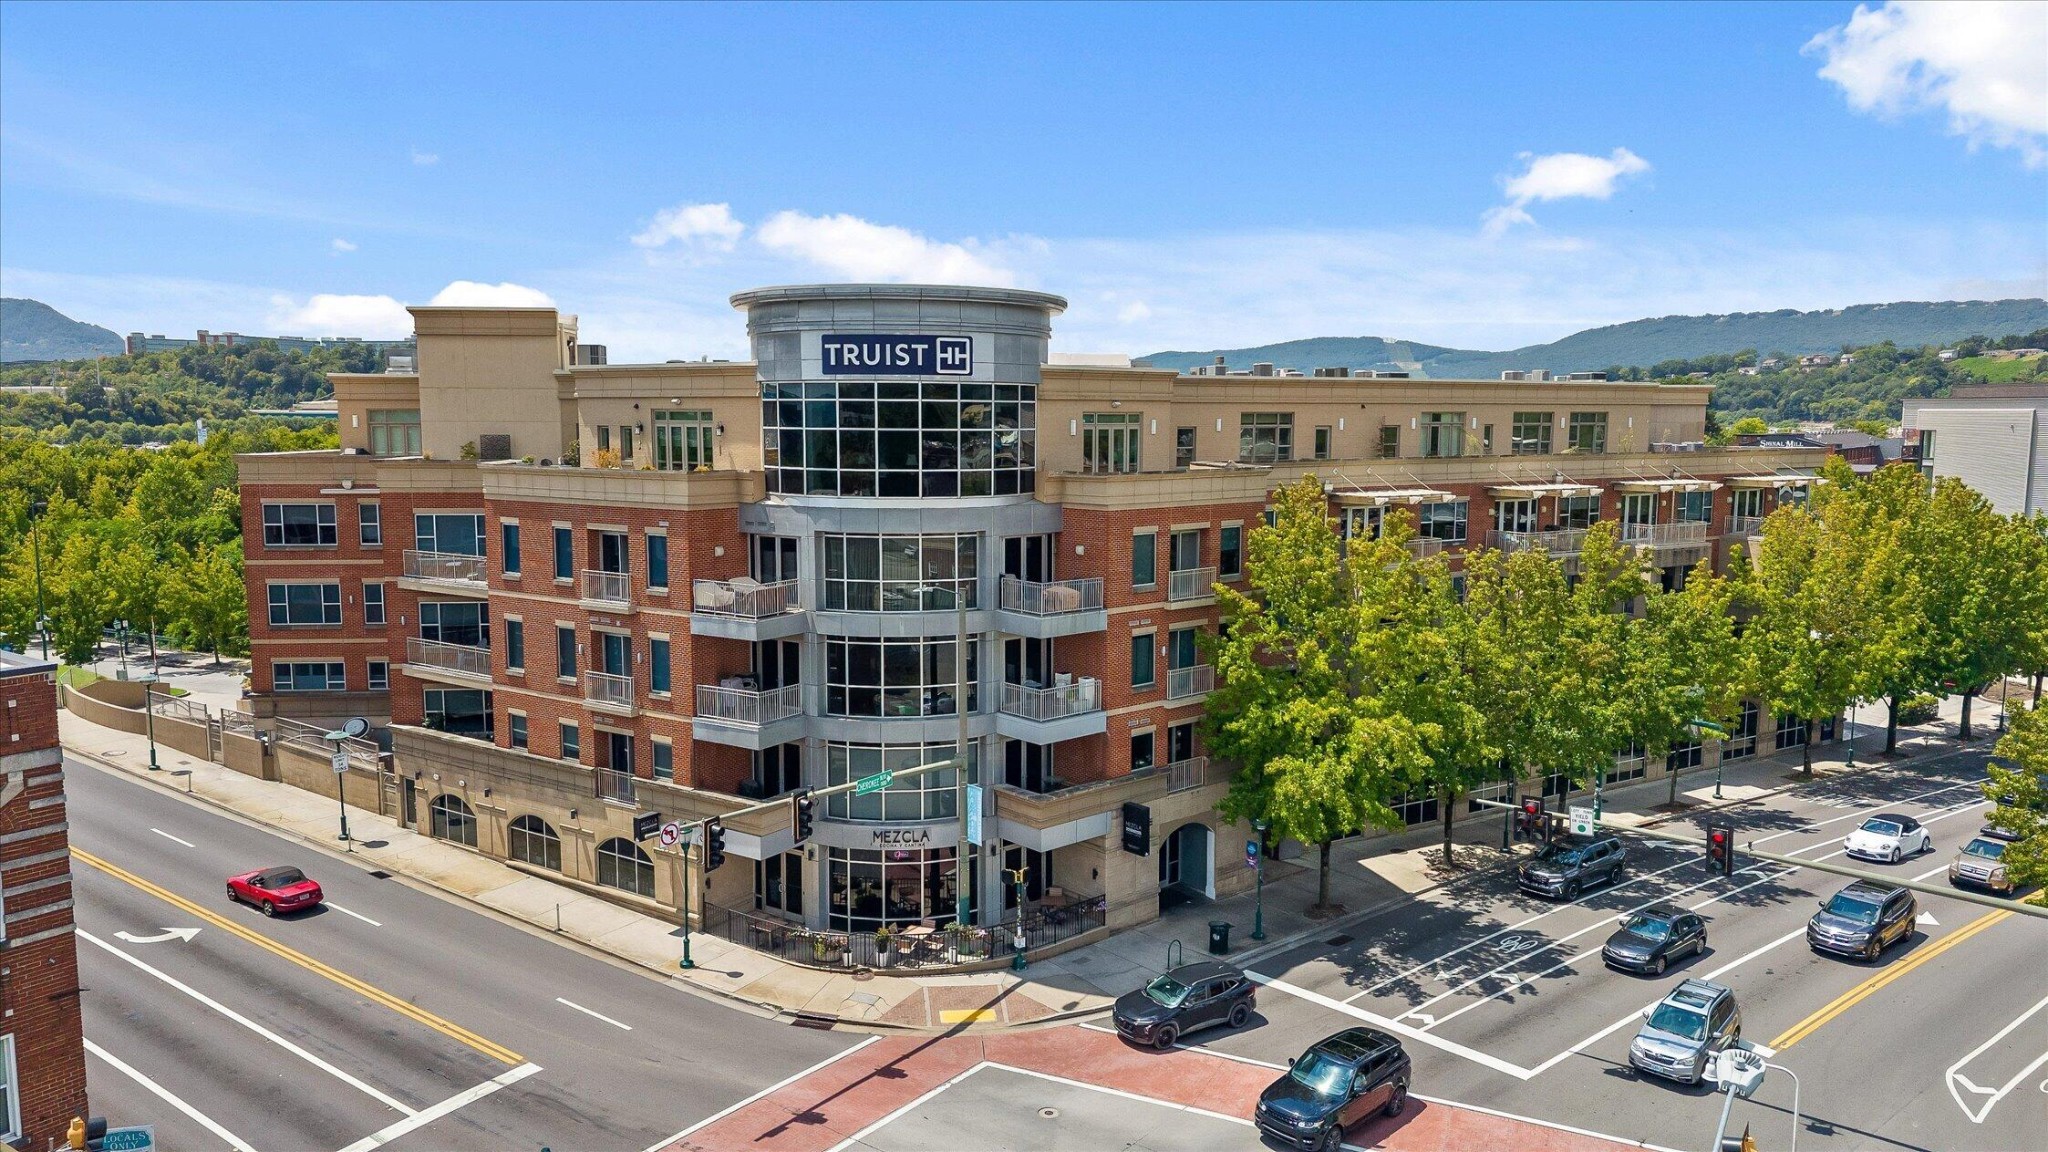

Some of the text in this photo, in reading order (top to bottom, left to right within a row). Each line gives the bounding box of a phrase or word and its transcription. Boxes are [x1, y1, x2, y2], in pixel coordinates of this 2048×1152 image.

[824, 343, 929, 366] TRUIST
[873, 830, 930, 843] MEZCLA
[103, 1132, 146, 1144] LOCALS
[110, 1140, 139, 1150] ONLY
